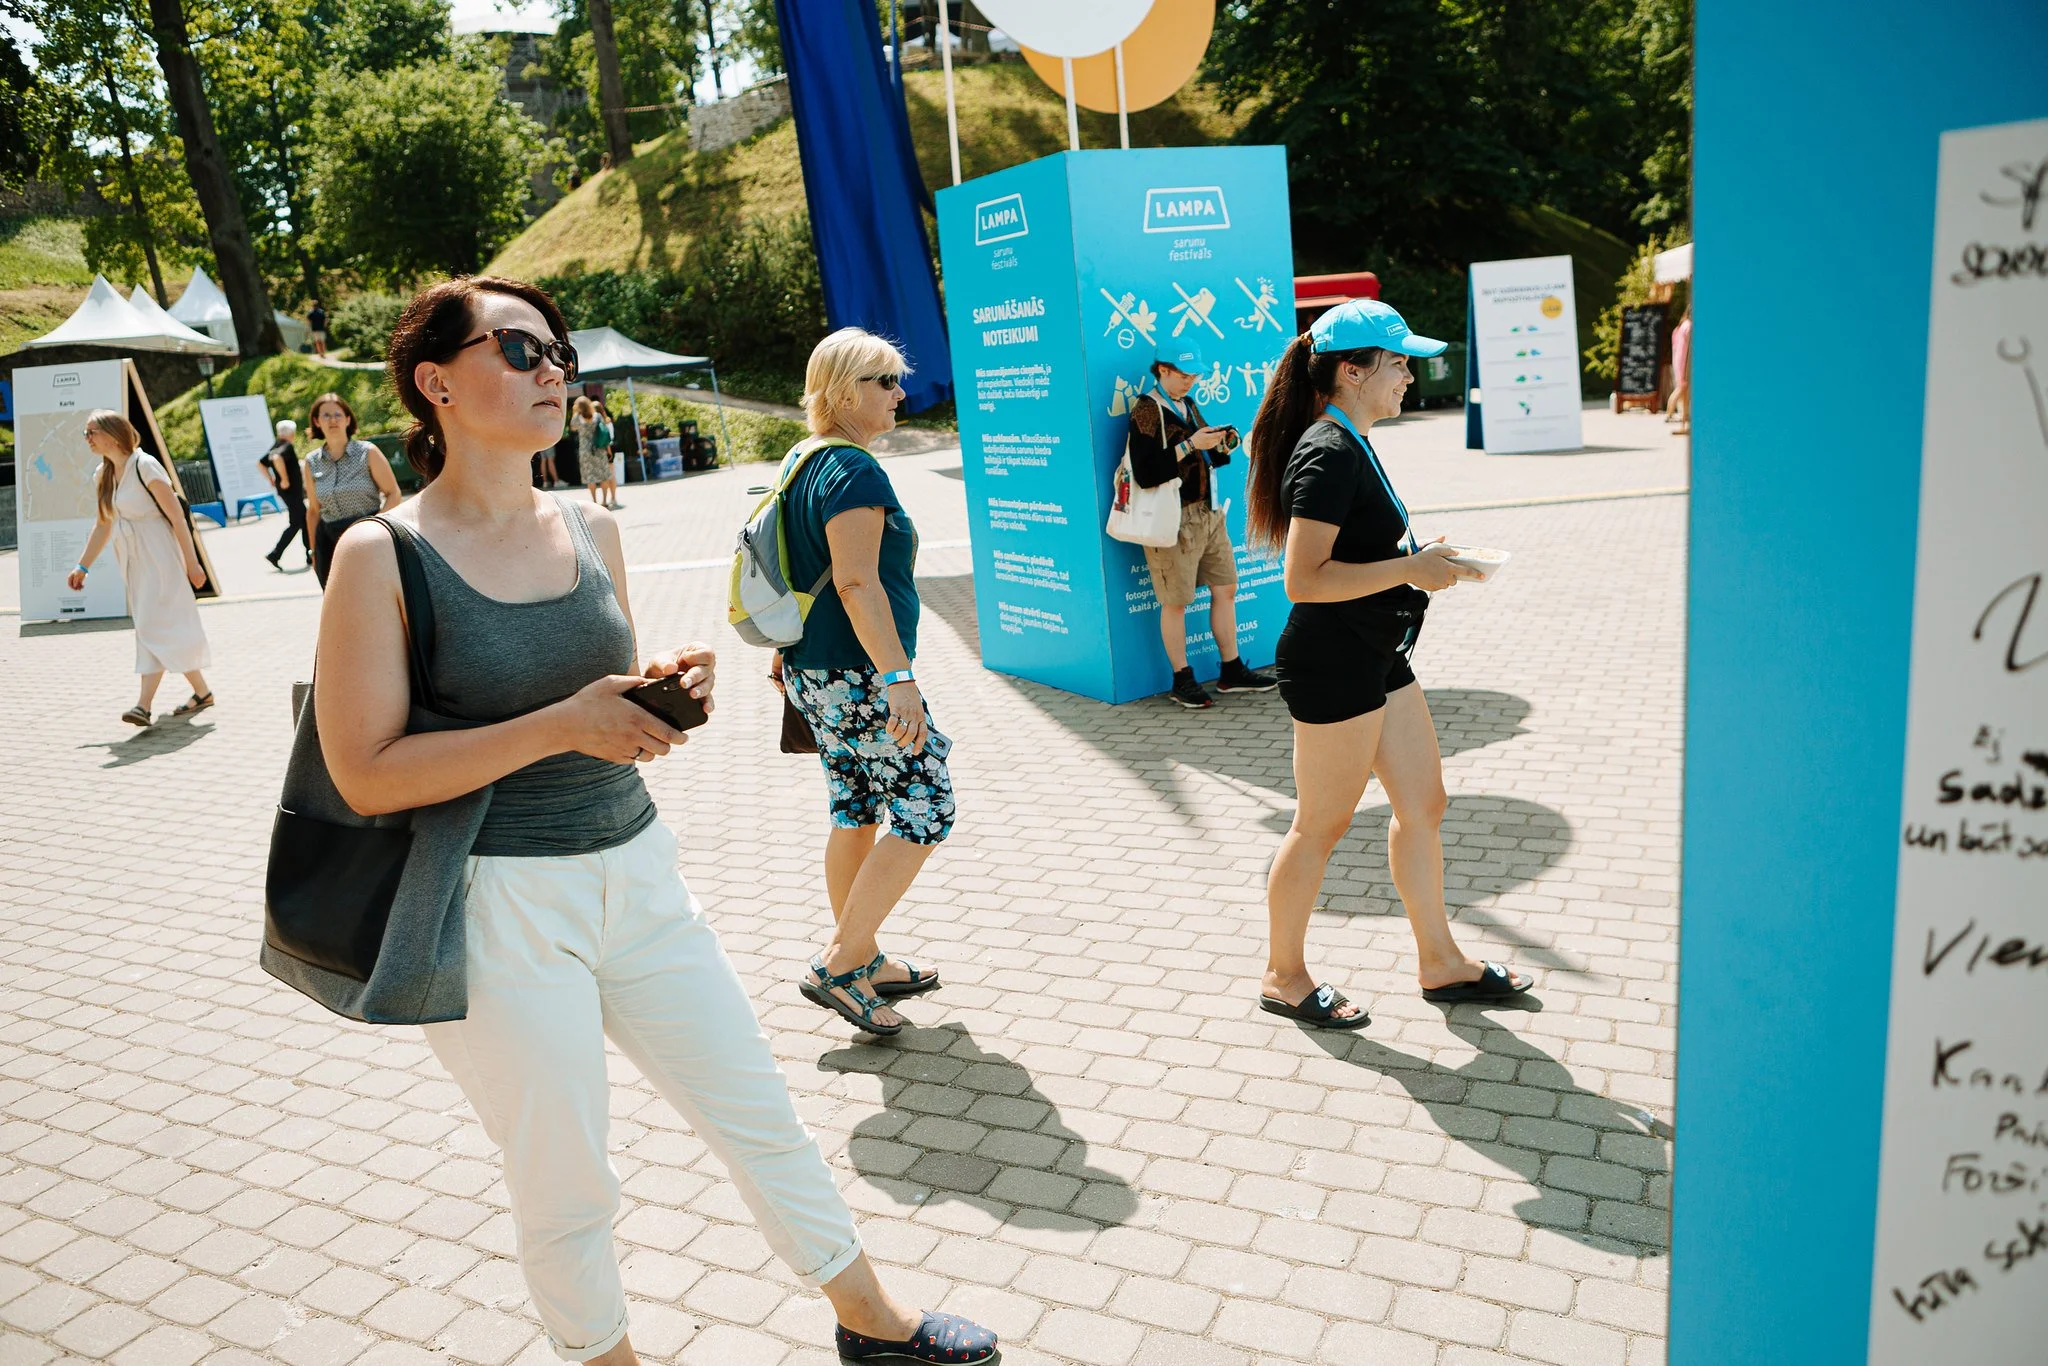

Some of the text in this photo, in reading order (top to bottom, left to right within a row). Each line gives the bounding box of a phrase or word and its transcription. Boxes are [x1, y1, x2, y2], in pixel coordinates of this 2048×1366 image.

[981, 207, 1019, 231] LAMPA
[1155, 199, 1216, 218] LAMPA
[1173, 238, 1206, 249] sarunu
[973, 296, 1046, 324] SARUNĀŠANĀS
[982, 325, 1039, 346] NOTEIKUMI
[1131, 565, 1140, 574] Ar
[1128, 601, 1152, 614] skaitā
[1240, 581, 1250, 589] un
